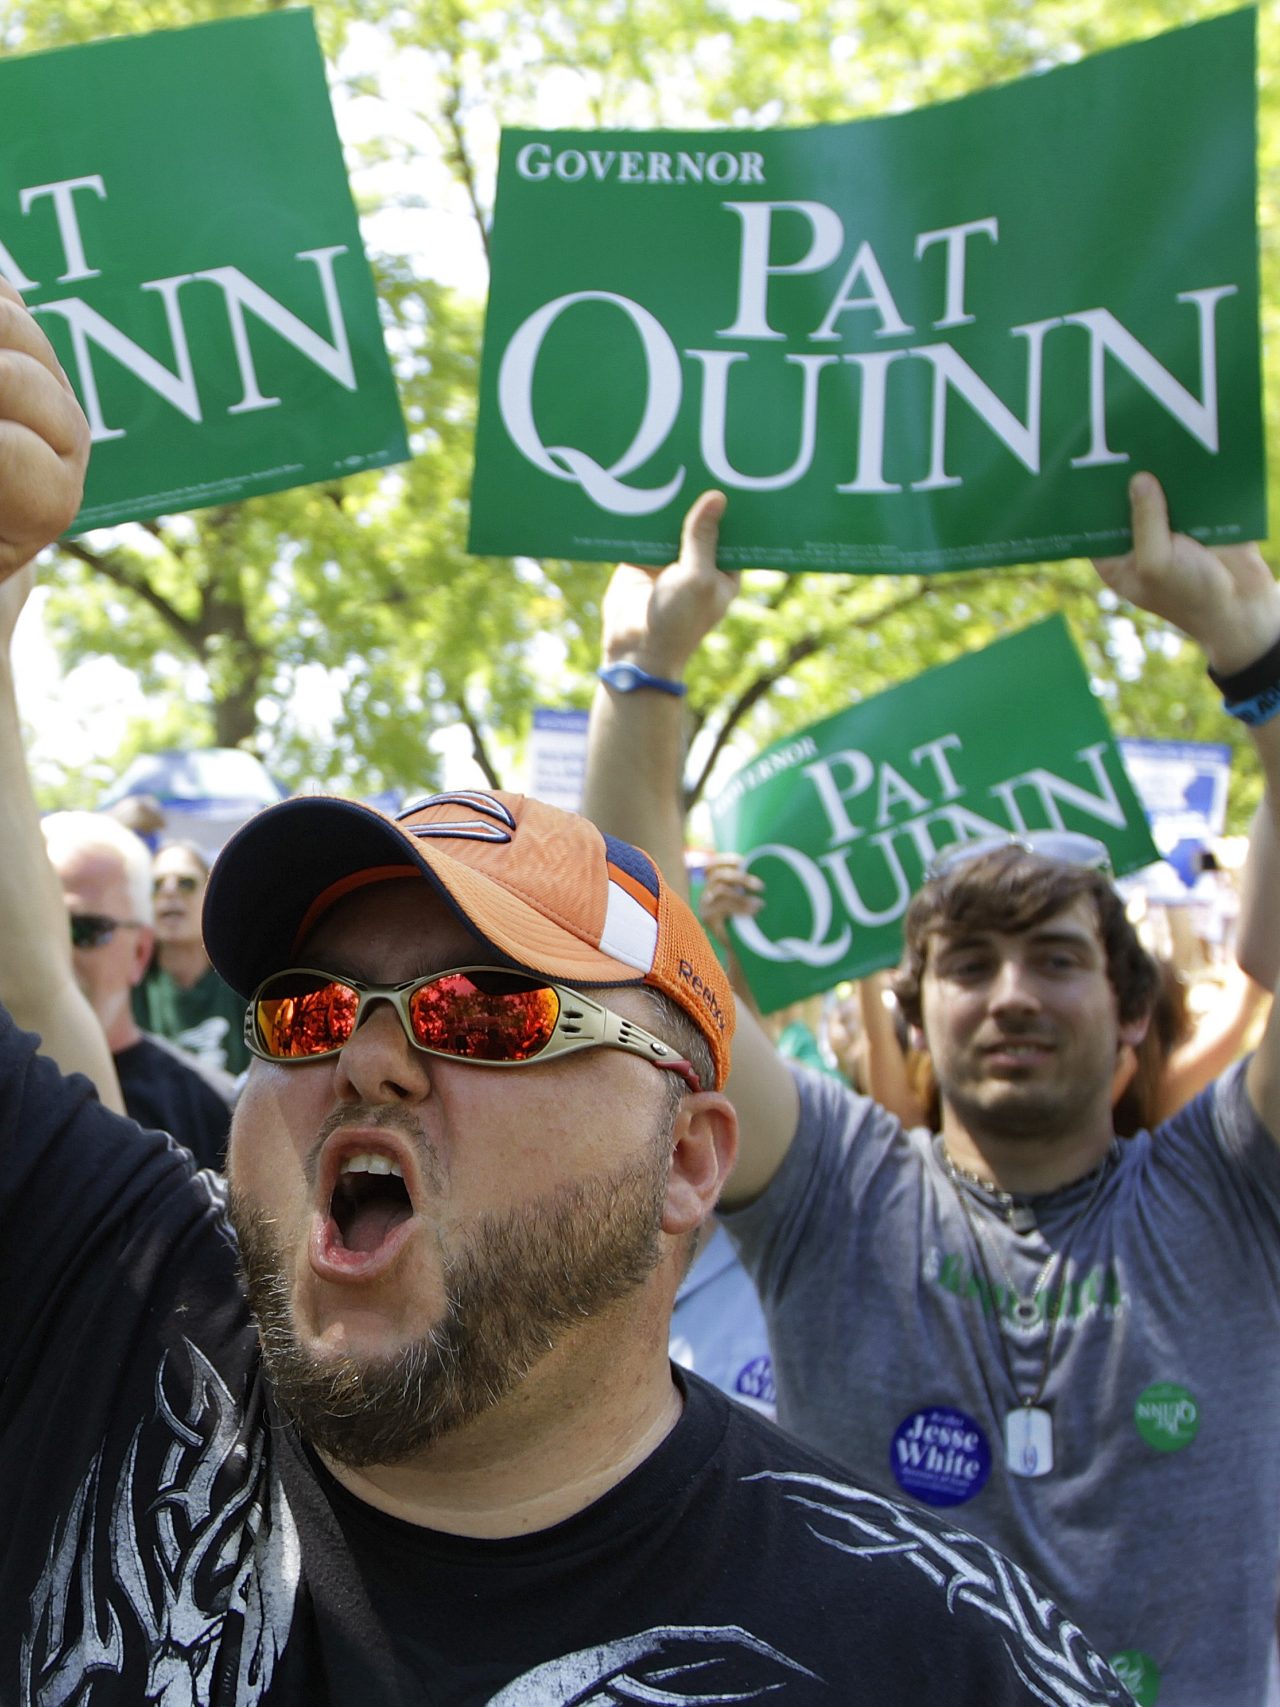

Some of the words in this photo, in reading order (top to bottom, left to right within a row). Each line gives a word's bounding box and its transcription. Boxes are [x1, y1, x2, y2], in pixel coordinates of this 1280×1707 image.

[516, 143, 766, 184] GOVERNOR
[716, 200, 999, 341] PAT
[498, 284, 1239, 517] QUINN
[803, 732, 964, 847] PAT
[730, 742, 1128, 967] QUINN
[896, 1437, 980, 1480] White
[905, 1413, 979, 1453] Jesse
